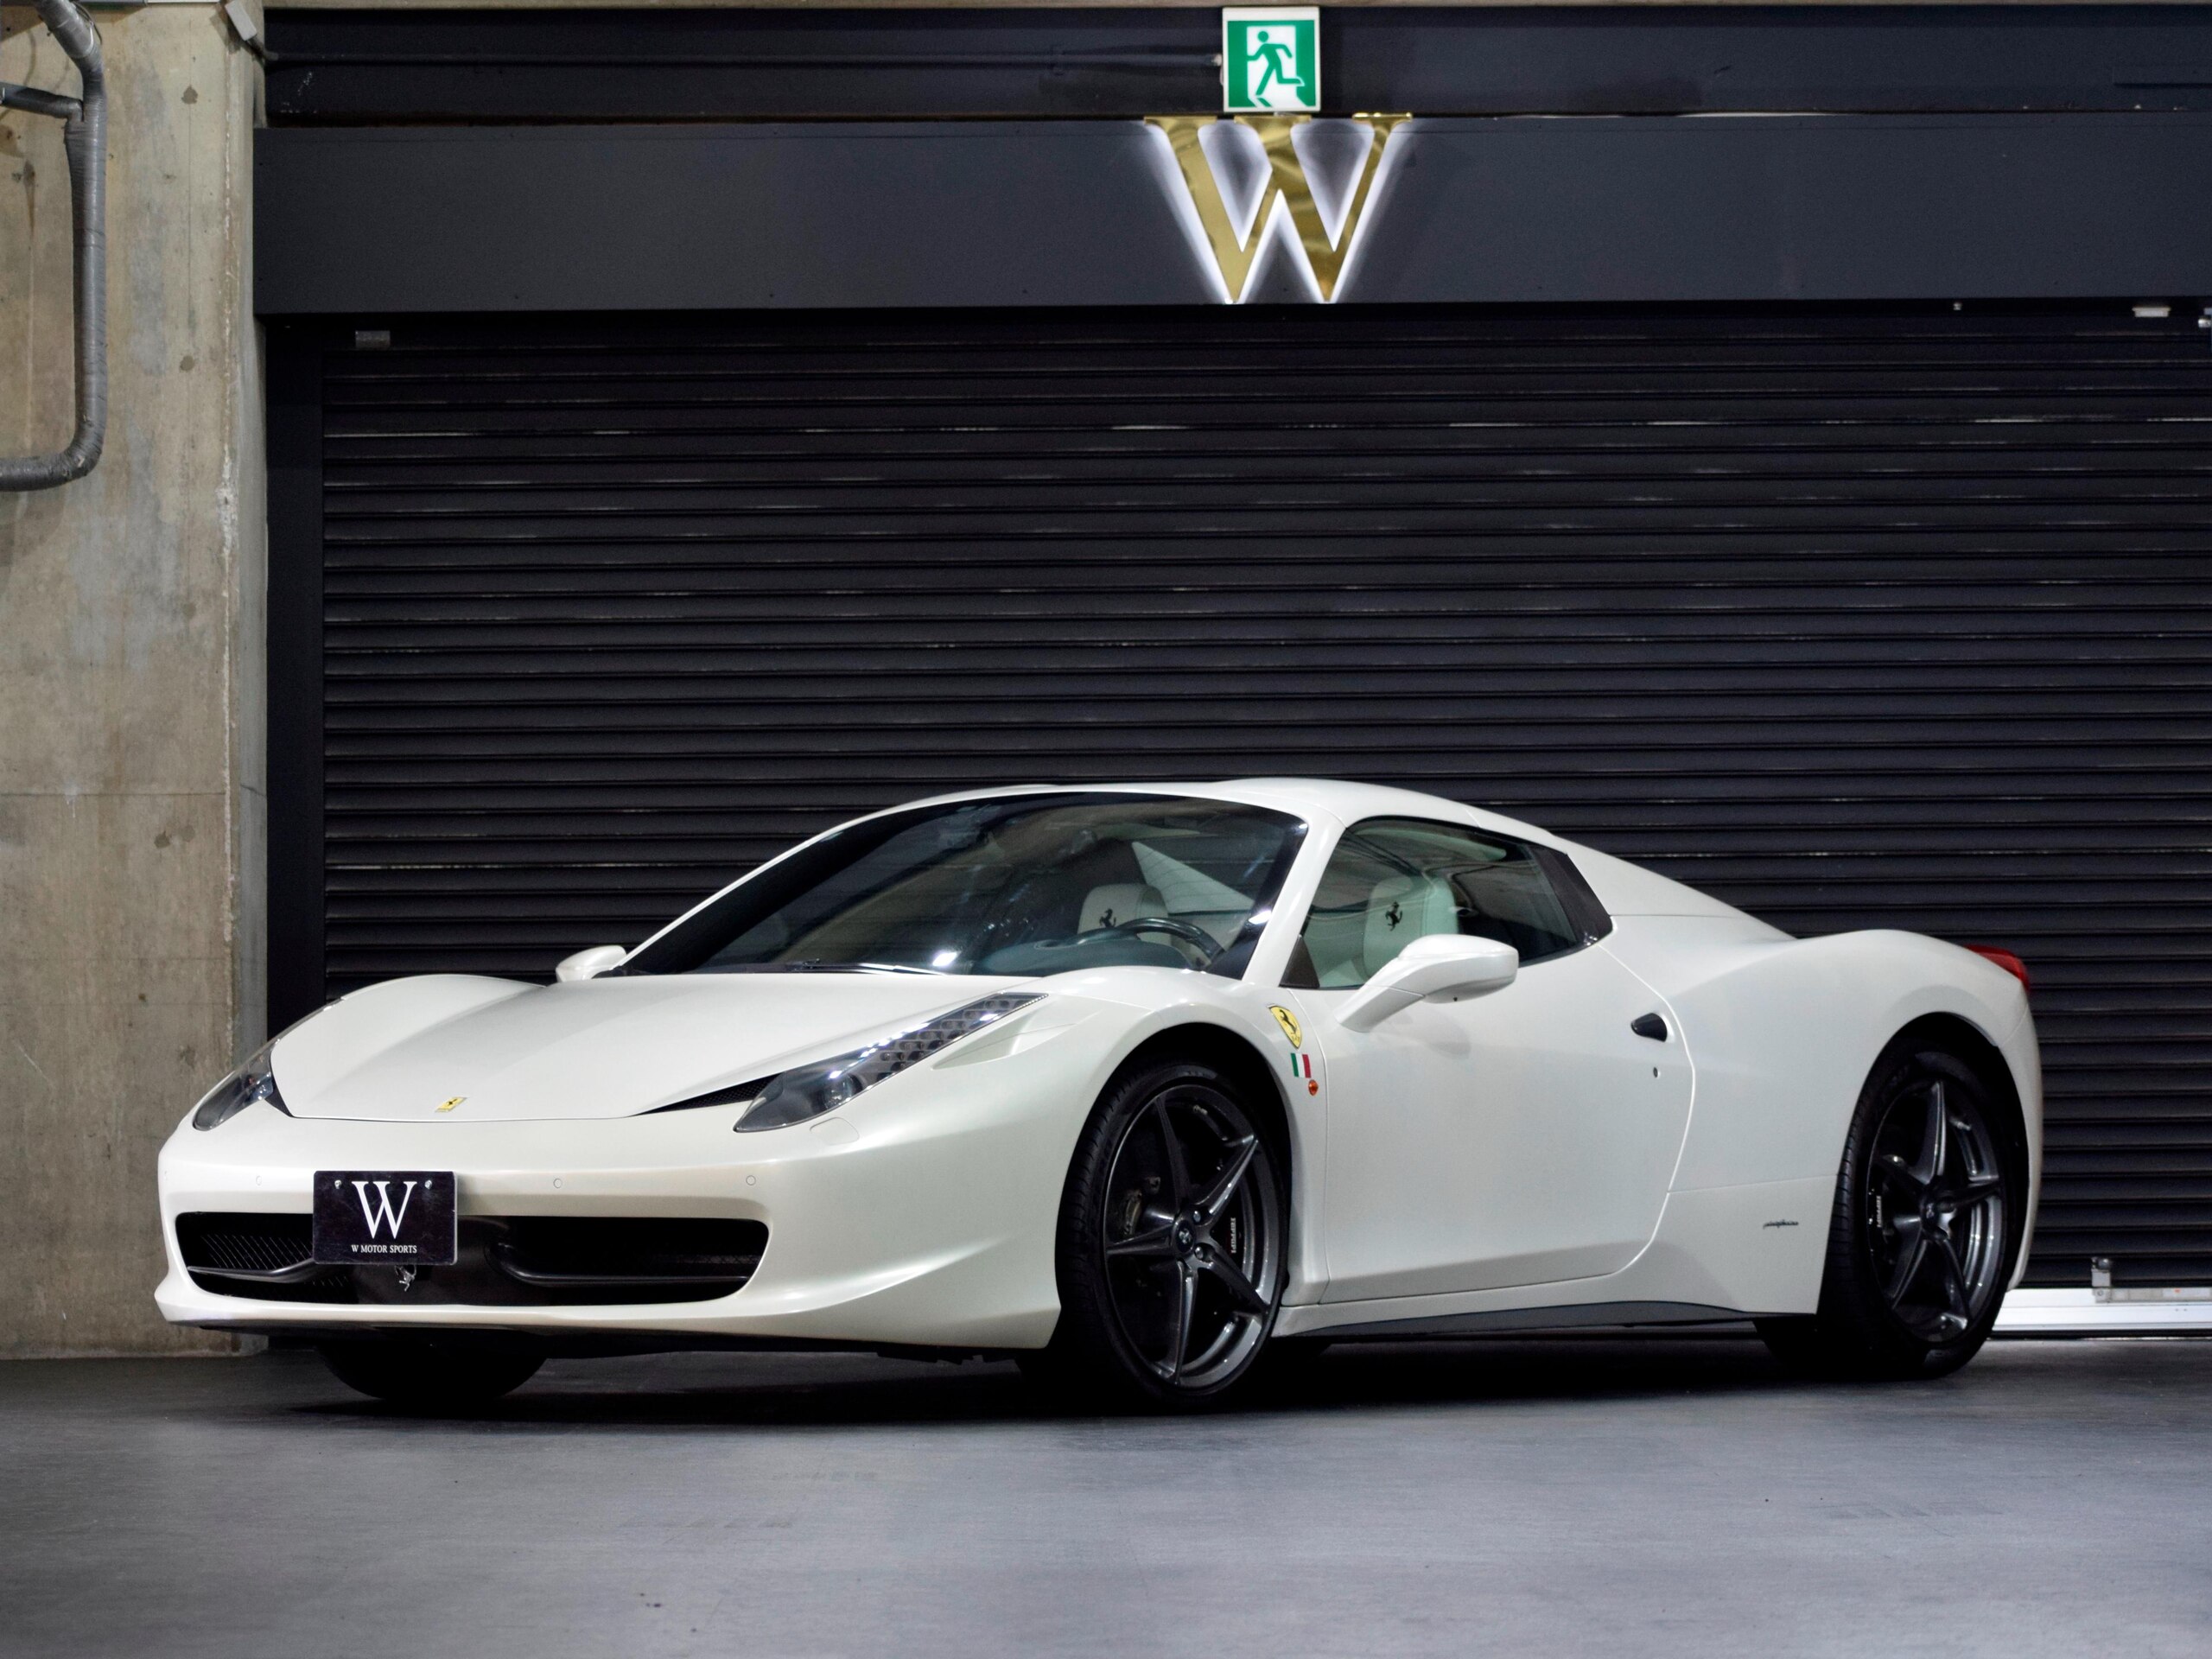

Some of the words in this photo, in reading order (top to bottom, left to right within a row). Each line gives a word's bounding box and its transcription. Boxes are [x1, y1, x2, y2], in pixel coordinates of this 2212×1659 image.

[1143, 113, 1413, 304] W
[351, 1181, 417, 1239] W
[351, 1244, 359, 1253] W
[360, 1244, 388, 1254] MOTOR
[389, 1244, 417, 1254] SPORTS
